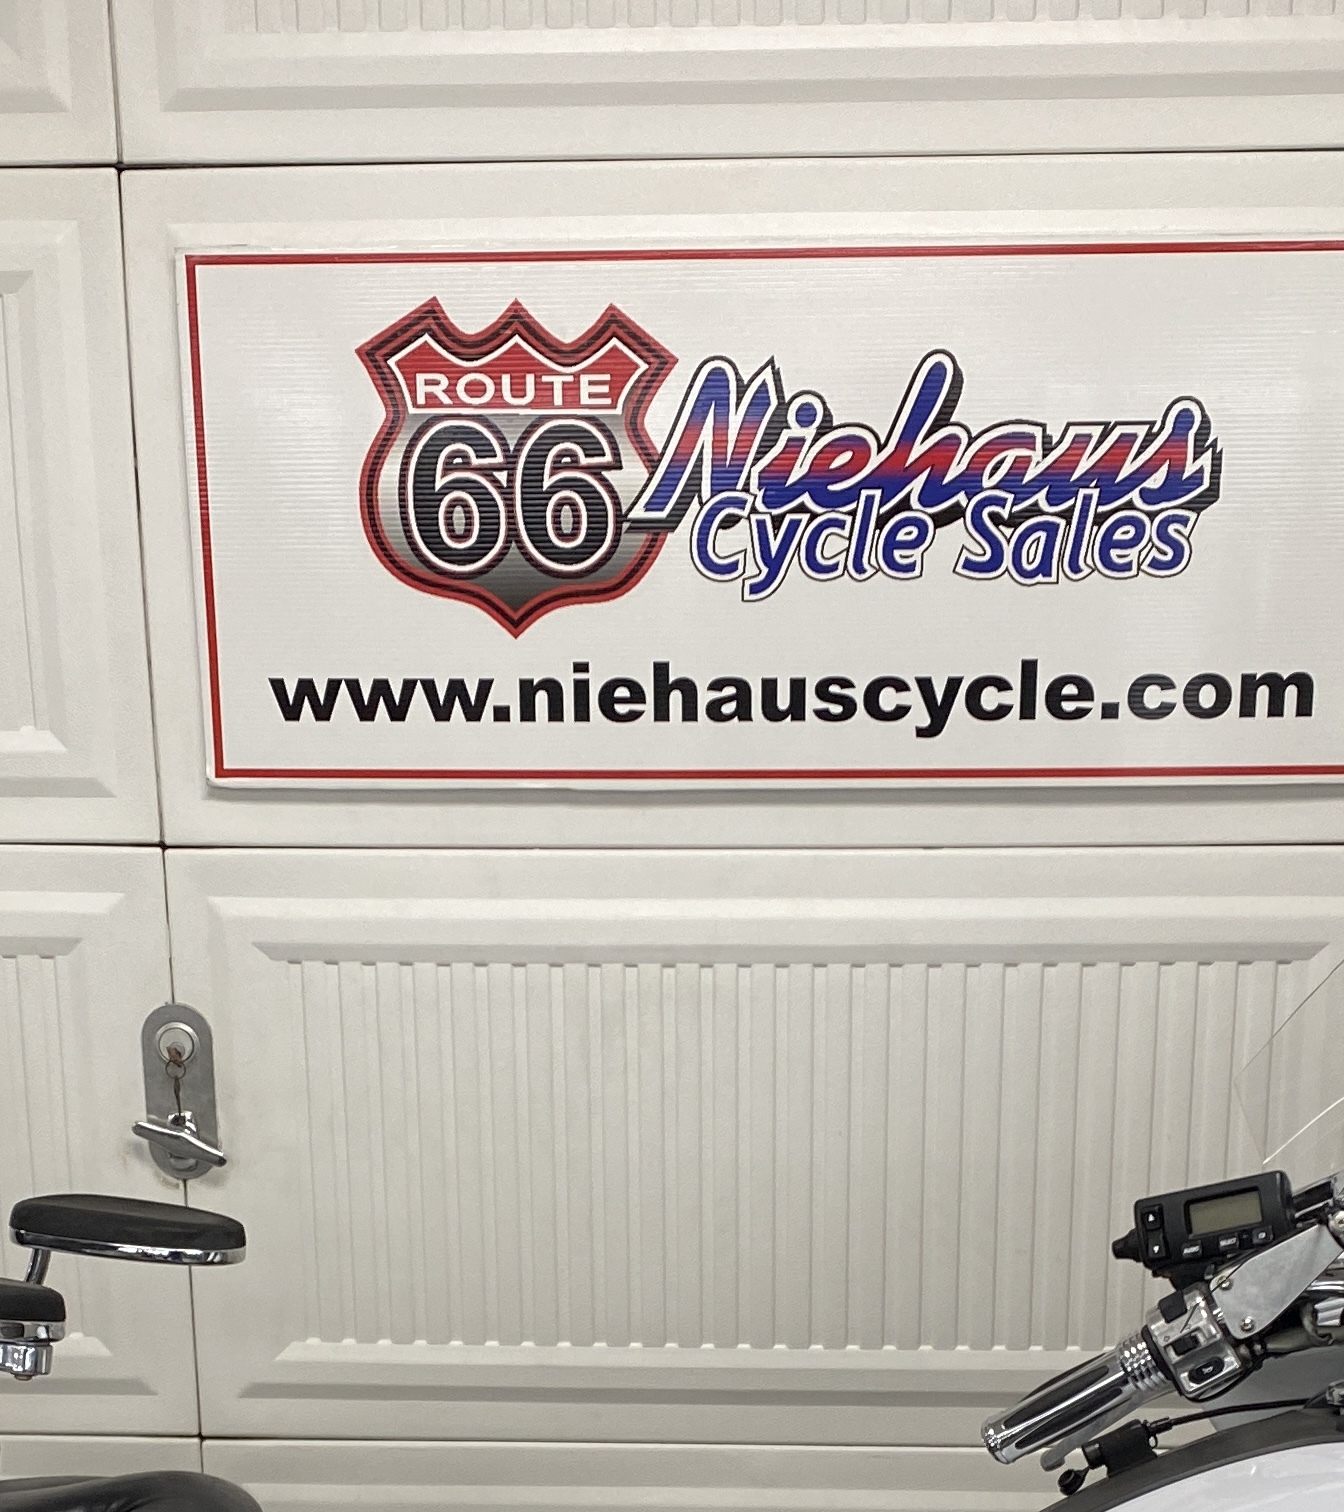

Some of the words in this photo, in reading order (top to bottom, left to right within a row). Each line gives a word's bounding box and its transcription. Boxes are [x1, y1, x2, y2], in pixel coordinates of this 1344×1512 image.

[414, 371, 613, 406] ROUTE
[634, 350, 1219, 522] Niehaus
[401, 414, 622, 578] 66
[691, 490, 935, 601] Cycle
[954, 487, 1198, 585] Sales
[267, 658, 1315, 739] www.niehauscycle.com
